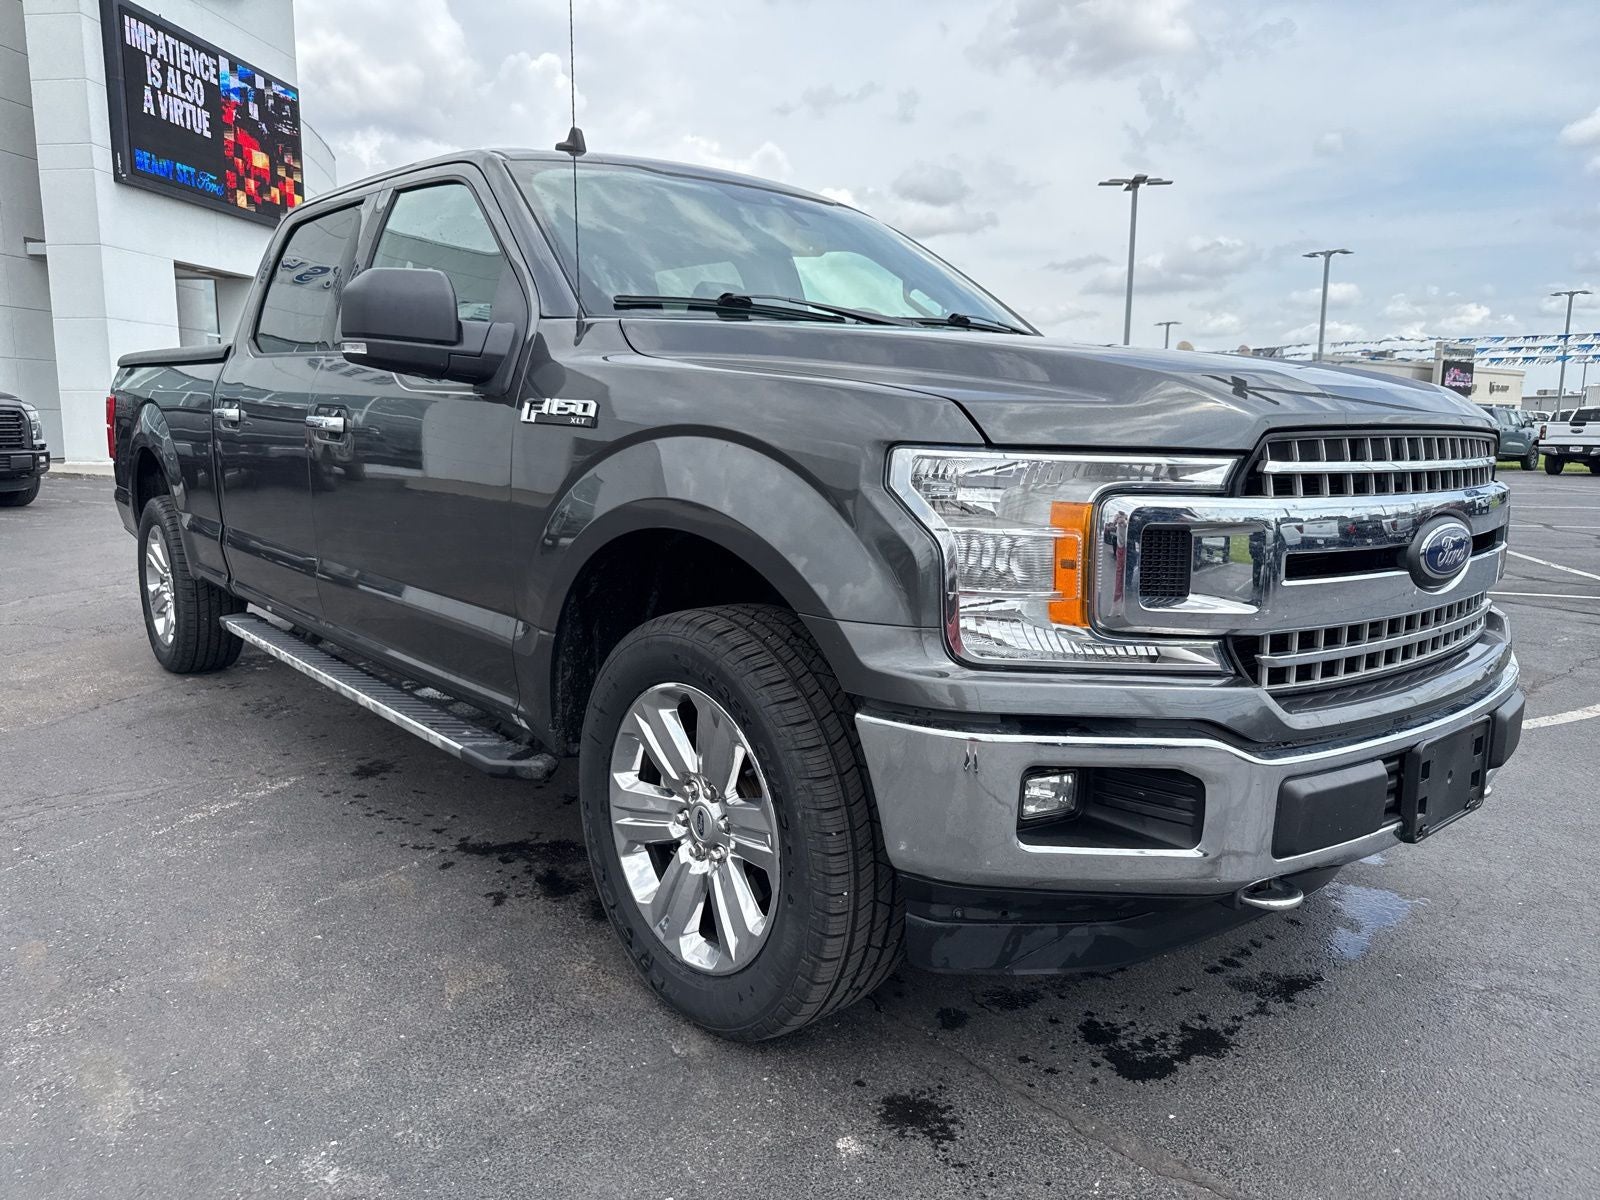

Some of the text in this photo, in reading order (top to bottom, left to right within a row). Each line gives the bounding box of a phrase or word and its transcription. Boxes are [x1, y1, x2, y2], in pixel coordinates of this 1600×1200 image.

[124, 14, 218, 86] IMPATIENCE
[145, 54, 205, 107] IS ALSO
[143, 85, 212, 138] A VIRTUE
[196, 171, 225, 196] Ford
[1437, 535, 1467, 568] Ford
